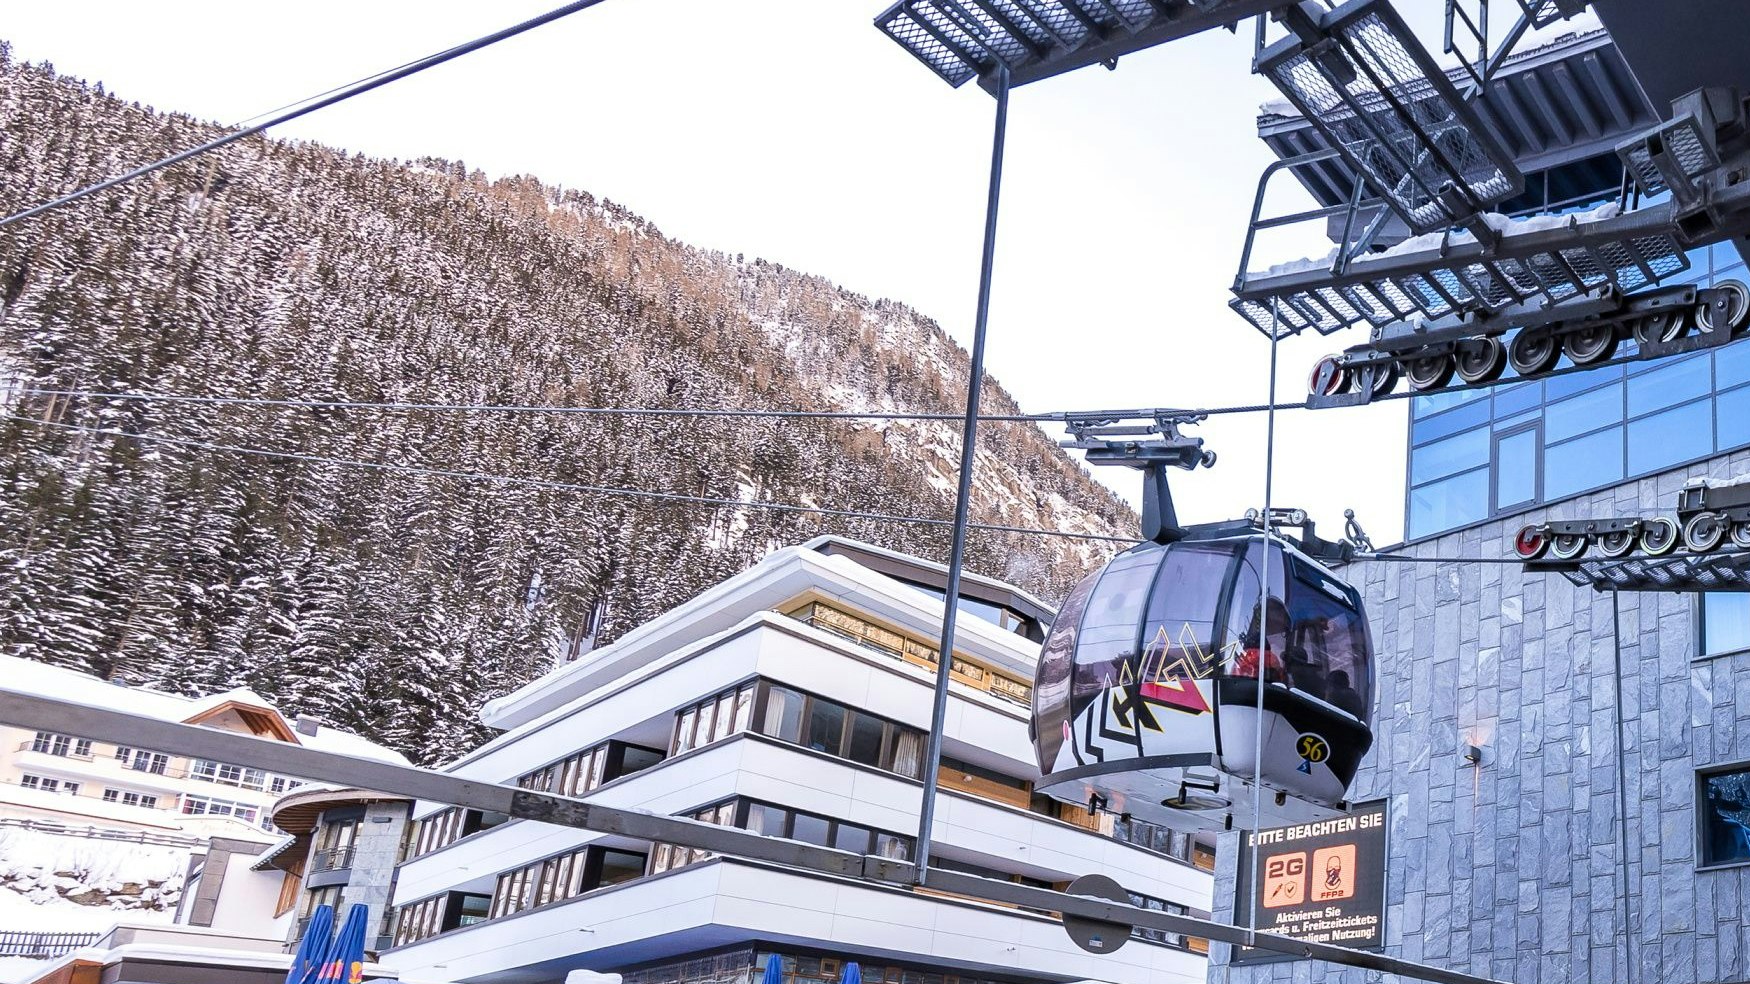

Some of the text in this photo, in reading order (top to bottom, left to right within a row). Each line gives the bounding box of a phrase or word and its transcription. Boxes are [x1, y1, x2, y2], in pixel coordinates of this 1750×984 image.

[1300, 735, 1323, 761] 56
[1286, 818, 1357, 840] BEACHTEN
[1360, 813, 1383, 828] SIE
[1268, 858, 1303, 878] 2G
[1320, 890, 1344, 899] FFP2
[1276, 907, 1341, 924] Aktivieren Sie
[1332, 926, 1376, 940] Nutzung!
